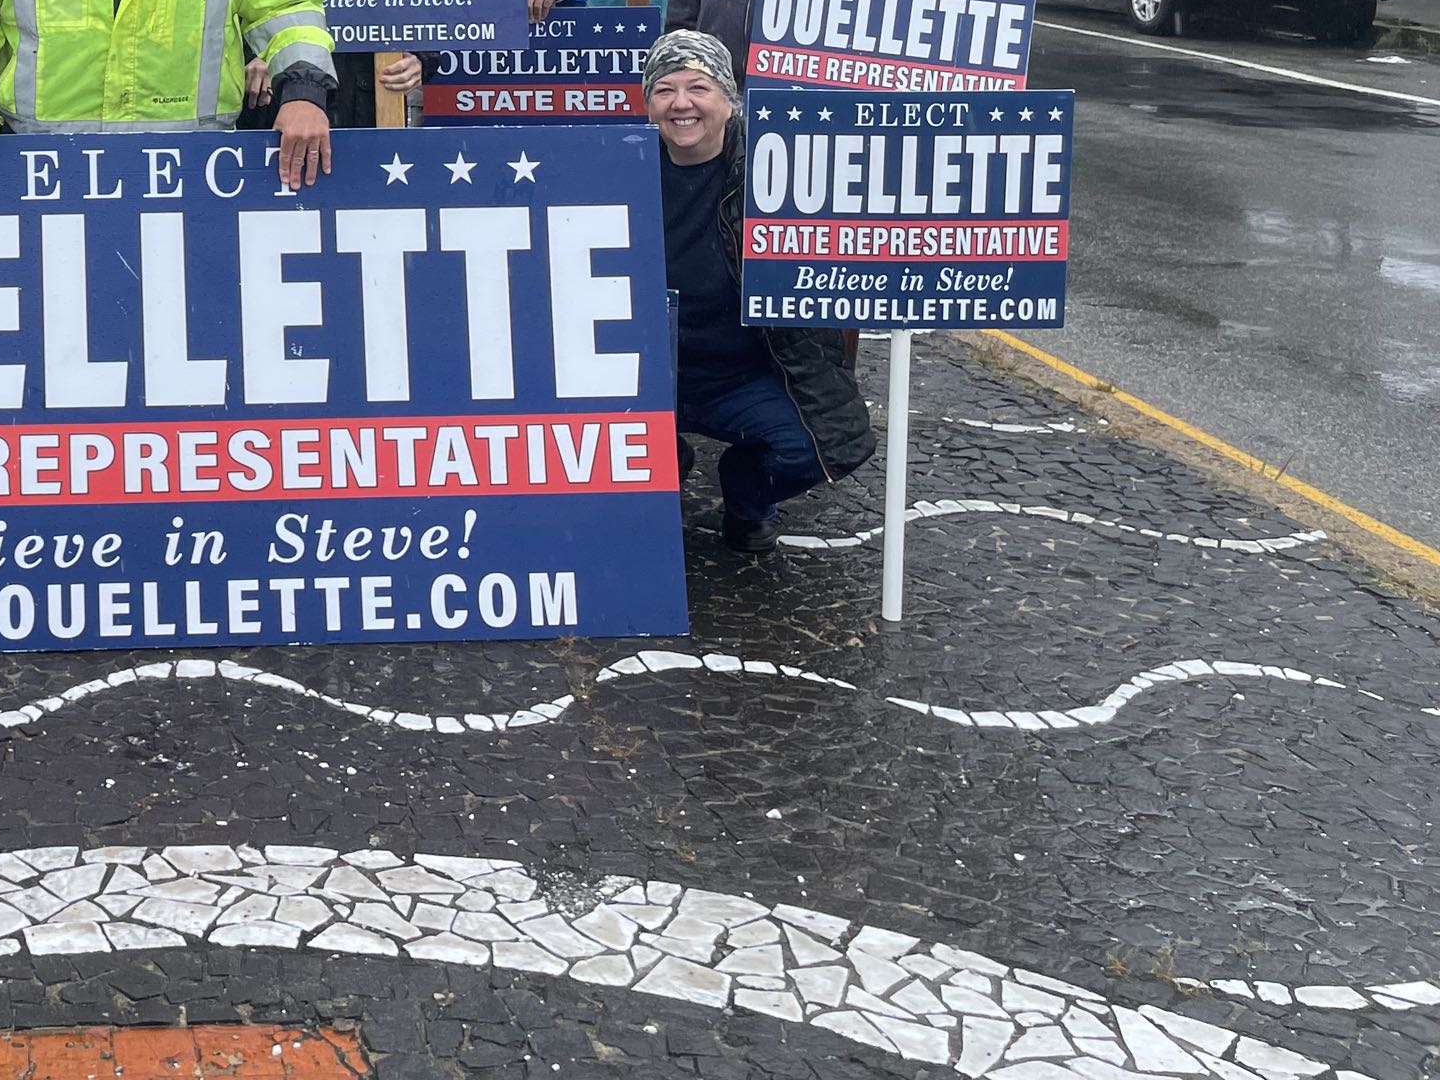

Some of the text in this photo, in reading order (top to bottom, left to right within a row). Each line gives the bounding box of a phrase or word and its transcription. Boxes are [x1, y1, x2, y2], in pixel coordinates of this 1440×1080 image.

[328, 23, 495, 42] TOUELLETTE.COM
[529, 21, 576, 38] ECT
[755, 49, 820, 79] STATE
[456, 90, 631, 112] STATE REP.
[853, 102, 969, 127] ELECT
[751, 132, 1063, 214] OUELLETTE
[751, 224, 1059, 256] STATE REPRESENTATIVE
[793, 266, 1014, 292] Believe in Steve!
[748, 296, 1057, 321] ELECTOUELLETTE.COM
[165, 516, 227, 566] in
[267, 509, 477, 564] Steve!
